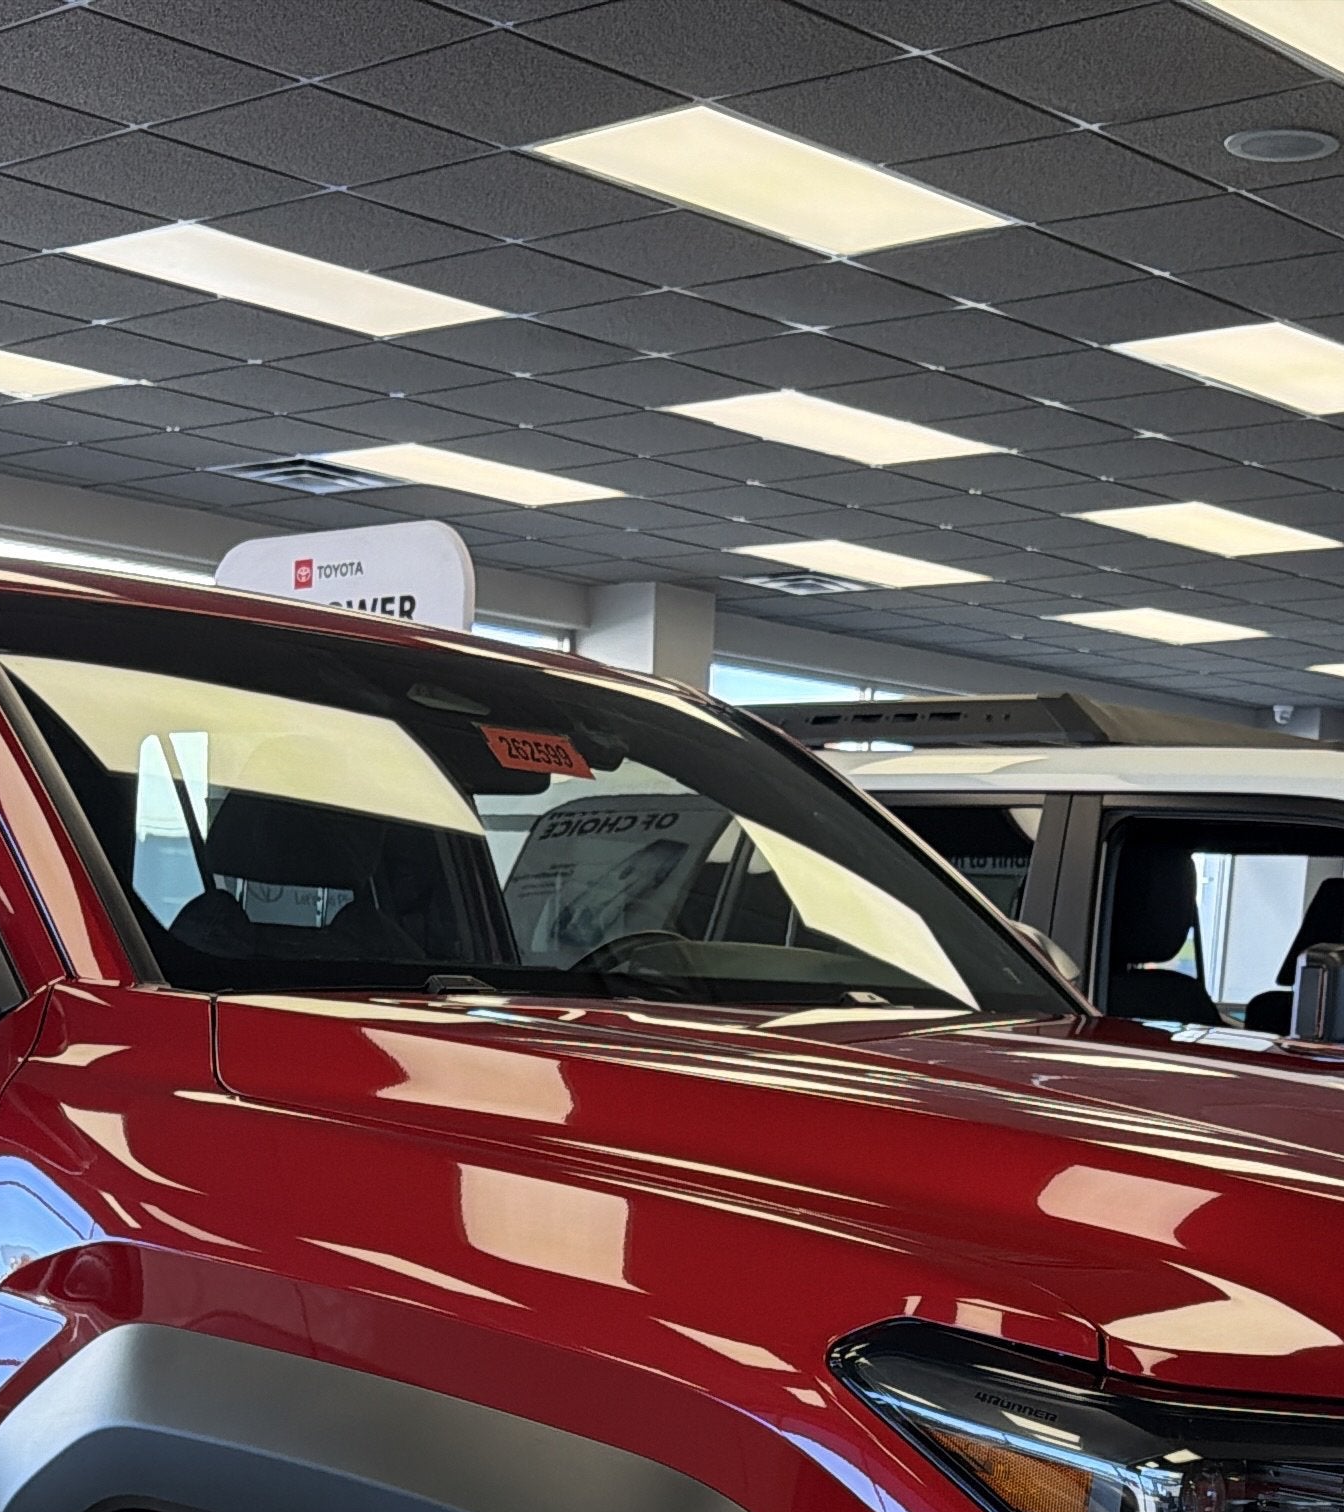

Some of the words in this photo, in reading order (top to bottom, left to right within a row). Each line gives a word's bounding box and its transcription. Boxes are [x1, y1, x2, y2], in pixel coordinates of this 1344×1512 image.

[317, 561, 363, 579] TOYOTA
[498, 736, 574, 769] 262599
[974, 1391, 1058, 1422] 4RUNNER
